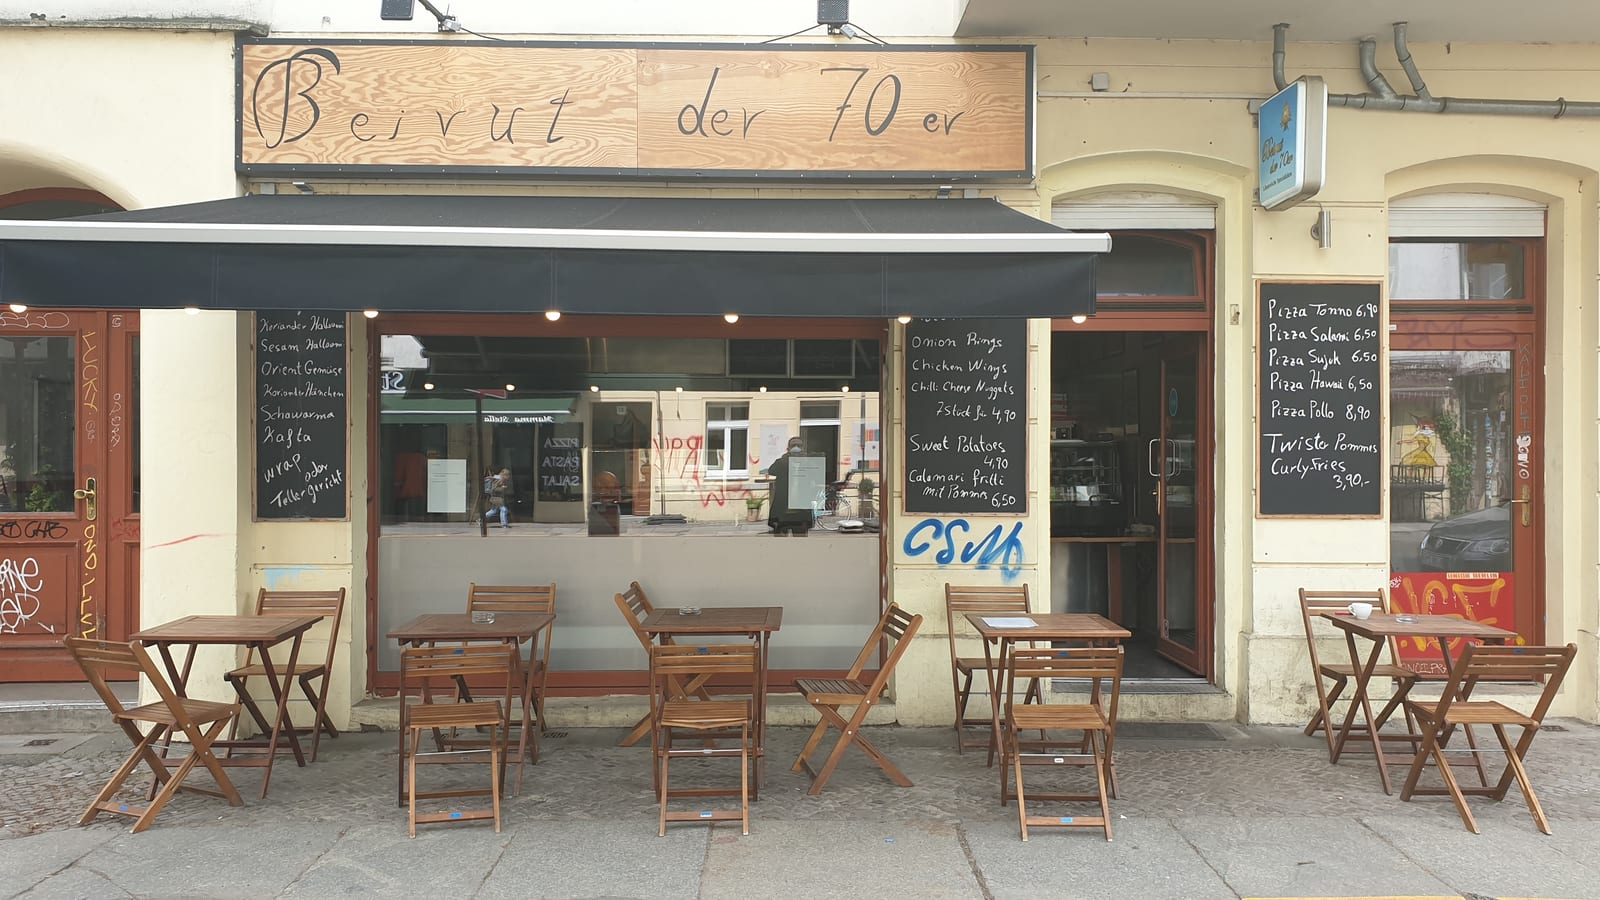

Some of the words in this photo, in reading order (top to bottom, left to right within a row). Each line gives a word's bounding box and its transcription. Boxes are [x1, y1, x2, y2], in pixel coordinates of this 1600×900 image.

[252, 47, 574, 149] Beirut
[677, 66, 767, 140] der
[1268, 298, 1308, 319] Pizza
[1308, 303, 1352, 317] Tonno
[1356, 303, 1378, 318] 6,90
[1269, 322, 1308, 342] Pizza
[1310, 326, 1350, 342] Salami
[1354, 328, 1377, 340] 6,50
[261, 338, 300, 352] Sesam
[912, 336, 956, 348] Onion
[966, 332, 1002, 354] Rings
[262, 361, 302, 376] Orient
[304, 360, 342, 376] Gemüse
[912, 358, 963, 372] Chicken
[968, 359, 1008, 380] Wings
[1269, 348, 1304, 366] Pizza
[1308, 348, 1341, 370] Sujuk
[1352, 350, 1378, 362] 6,50
[942, 381, 971, 394] Cheese
[976, 380, 1014, 400] Nuggets
[1270, 372, 1304, 392] Pizza
[1309, 369, 1344, 390] Hawaii
[1348, 376, 1372, 392] 6,50
[992, 406, 1016, 424] 4,90
[1272, 400, 1306, 419] Pizza
[1310, 400, 1334, 419] Pollo
[1346, 404, 1370, 422] 8,90
[263, 426, 312, 449] Kafta
[910, 433, 950, 452] Sweet
[958, 434, 1006, 452] Potatoes
[1334, 432, 1378, 454] Pommes
[984, 456, 1008, 470] 4,90
[909, 468, 964, 483] Calamari
[923, 486, 946, 498] mit
[948, 484, 988, 500] Pommes
[992, 492, 1016, 508] 6,50
